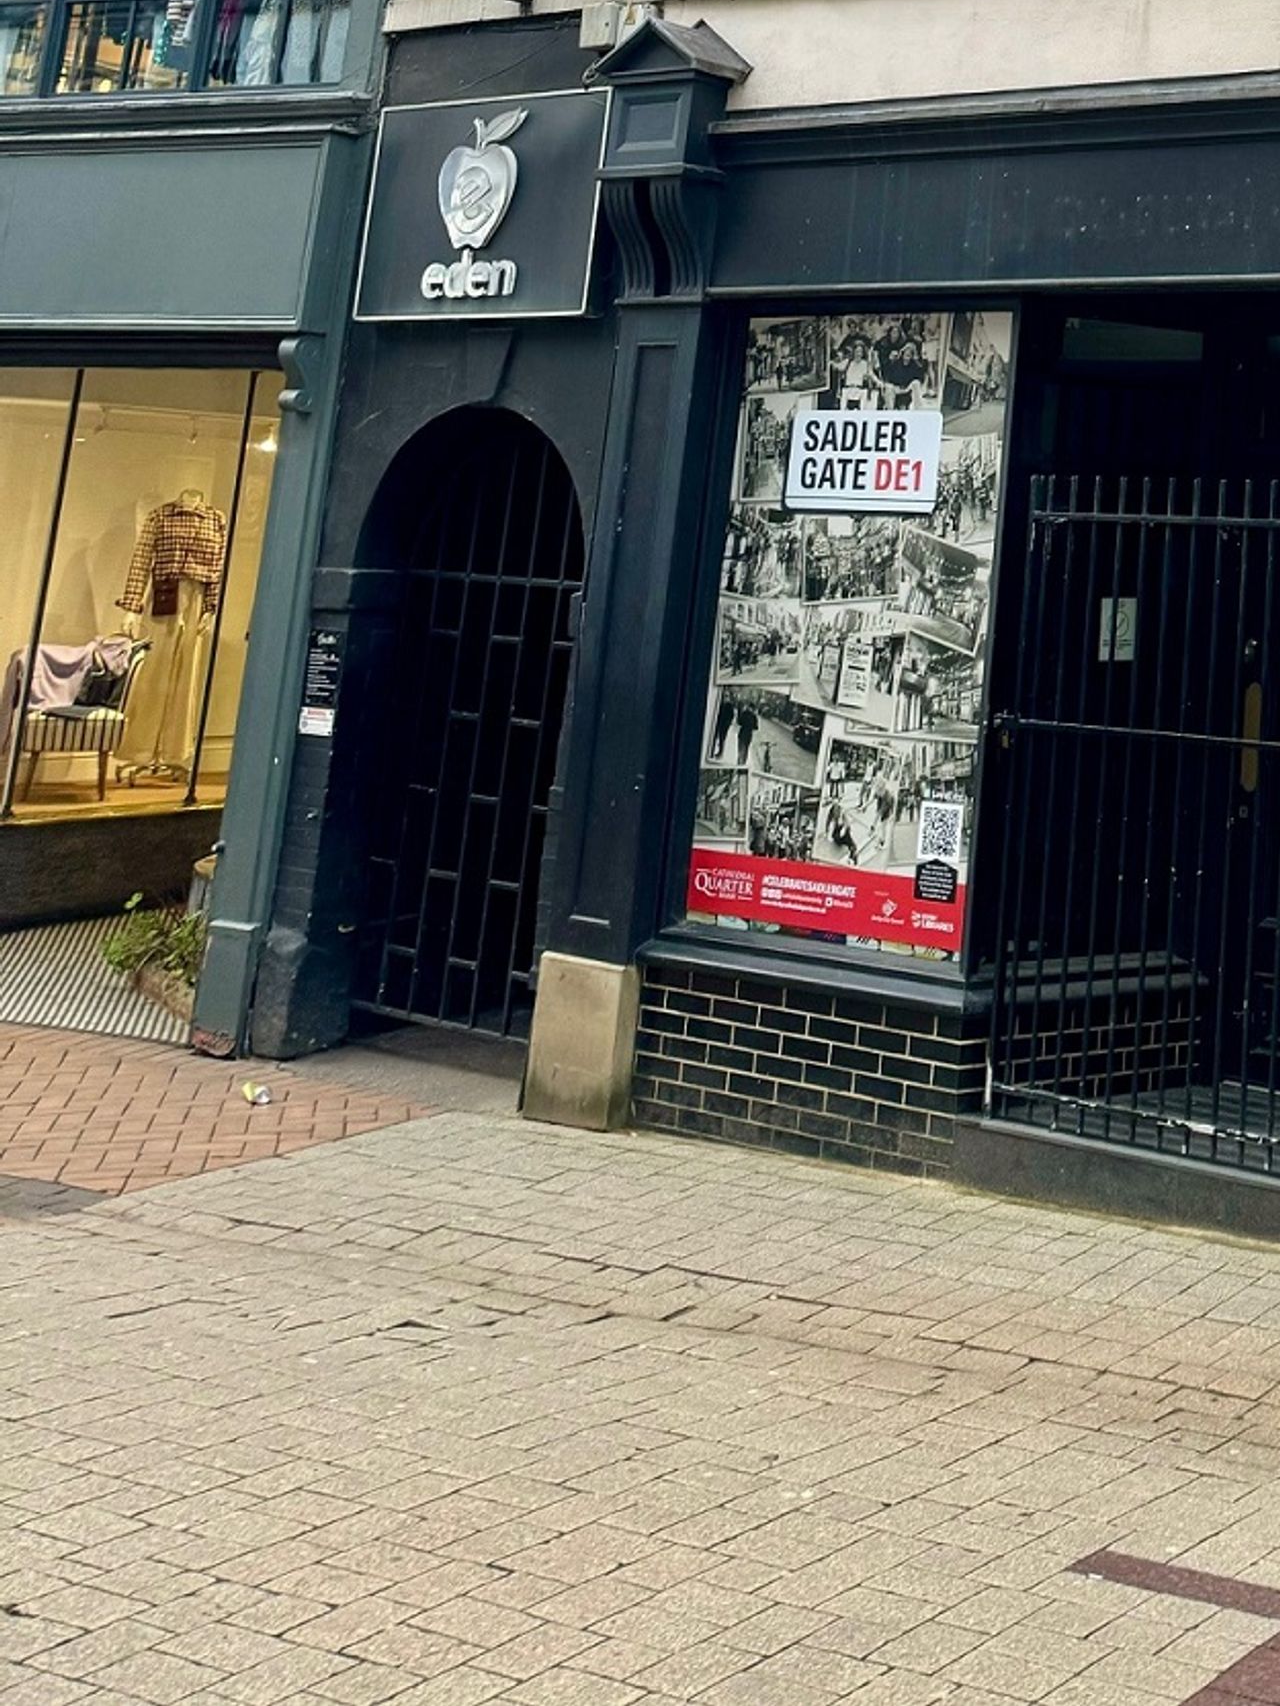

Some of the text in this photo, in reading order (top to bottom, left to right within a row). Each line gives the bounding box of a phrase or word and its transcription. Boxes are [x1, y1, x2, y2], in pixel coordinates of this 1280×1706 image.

[420, 248, 518, 299] eden
[803, 420, 908, 453] SADLER
[801, 457, 923, 492] GATE DE1
[694, 872, 753, 896] QUARTER
